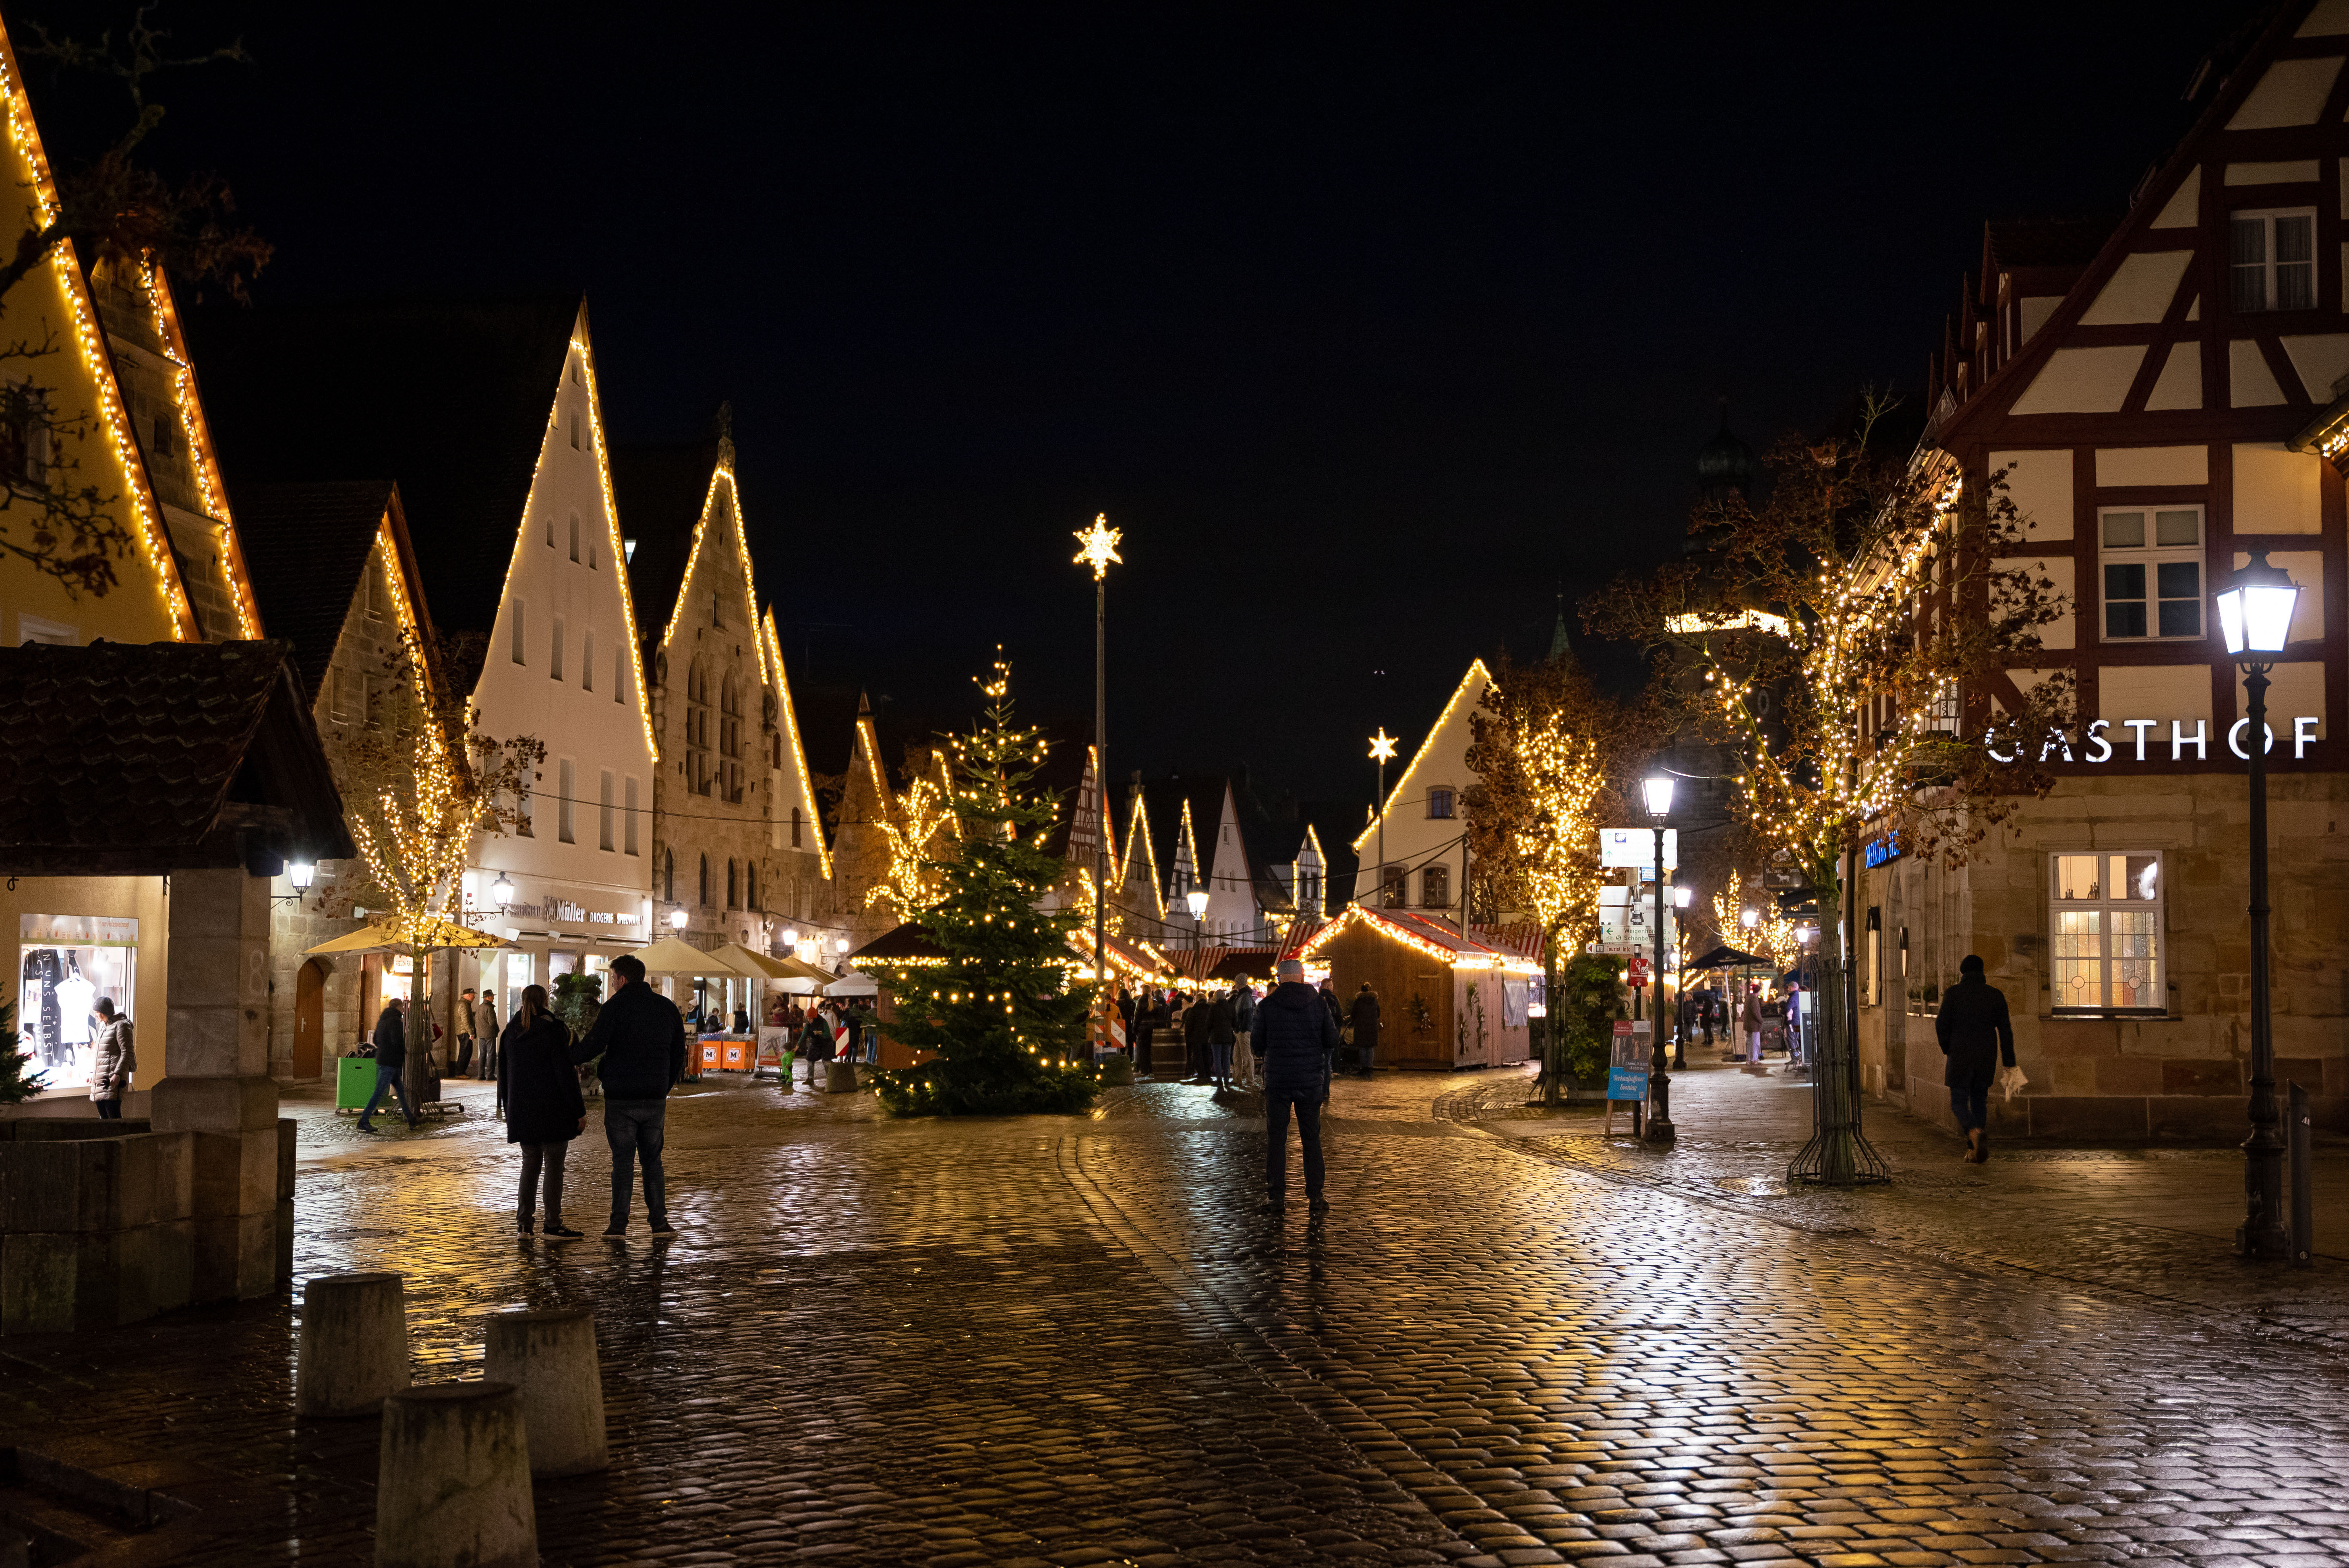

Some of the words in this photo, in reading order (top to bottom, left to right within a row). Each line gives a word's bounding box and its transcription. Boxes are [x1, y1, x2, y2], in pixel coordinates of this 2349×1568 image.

[1985, 717, 2318, 763] GASTHOF
[556, 900, 585, 923] Müller
[590, 912, 613, 924] DROGERIE
[43, 970, 51, 996] UNS
[43, 1007, 52, 1057] SELBST
[1613, 1074, 1645, 1083] Verkaufsoffener
